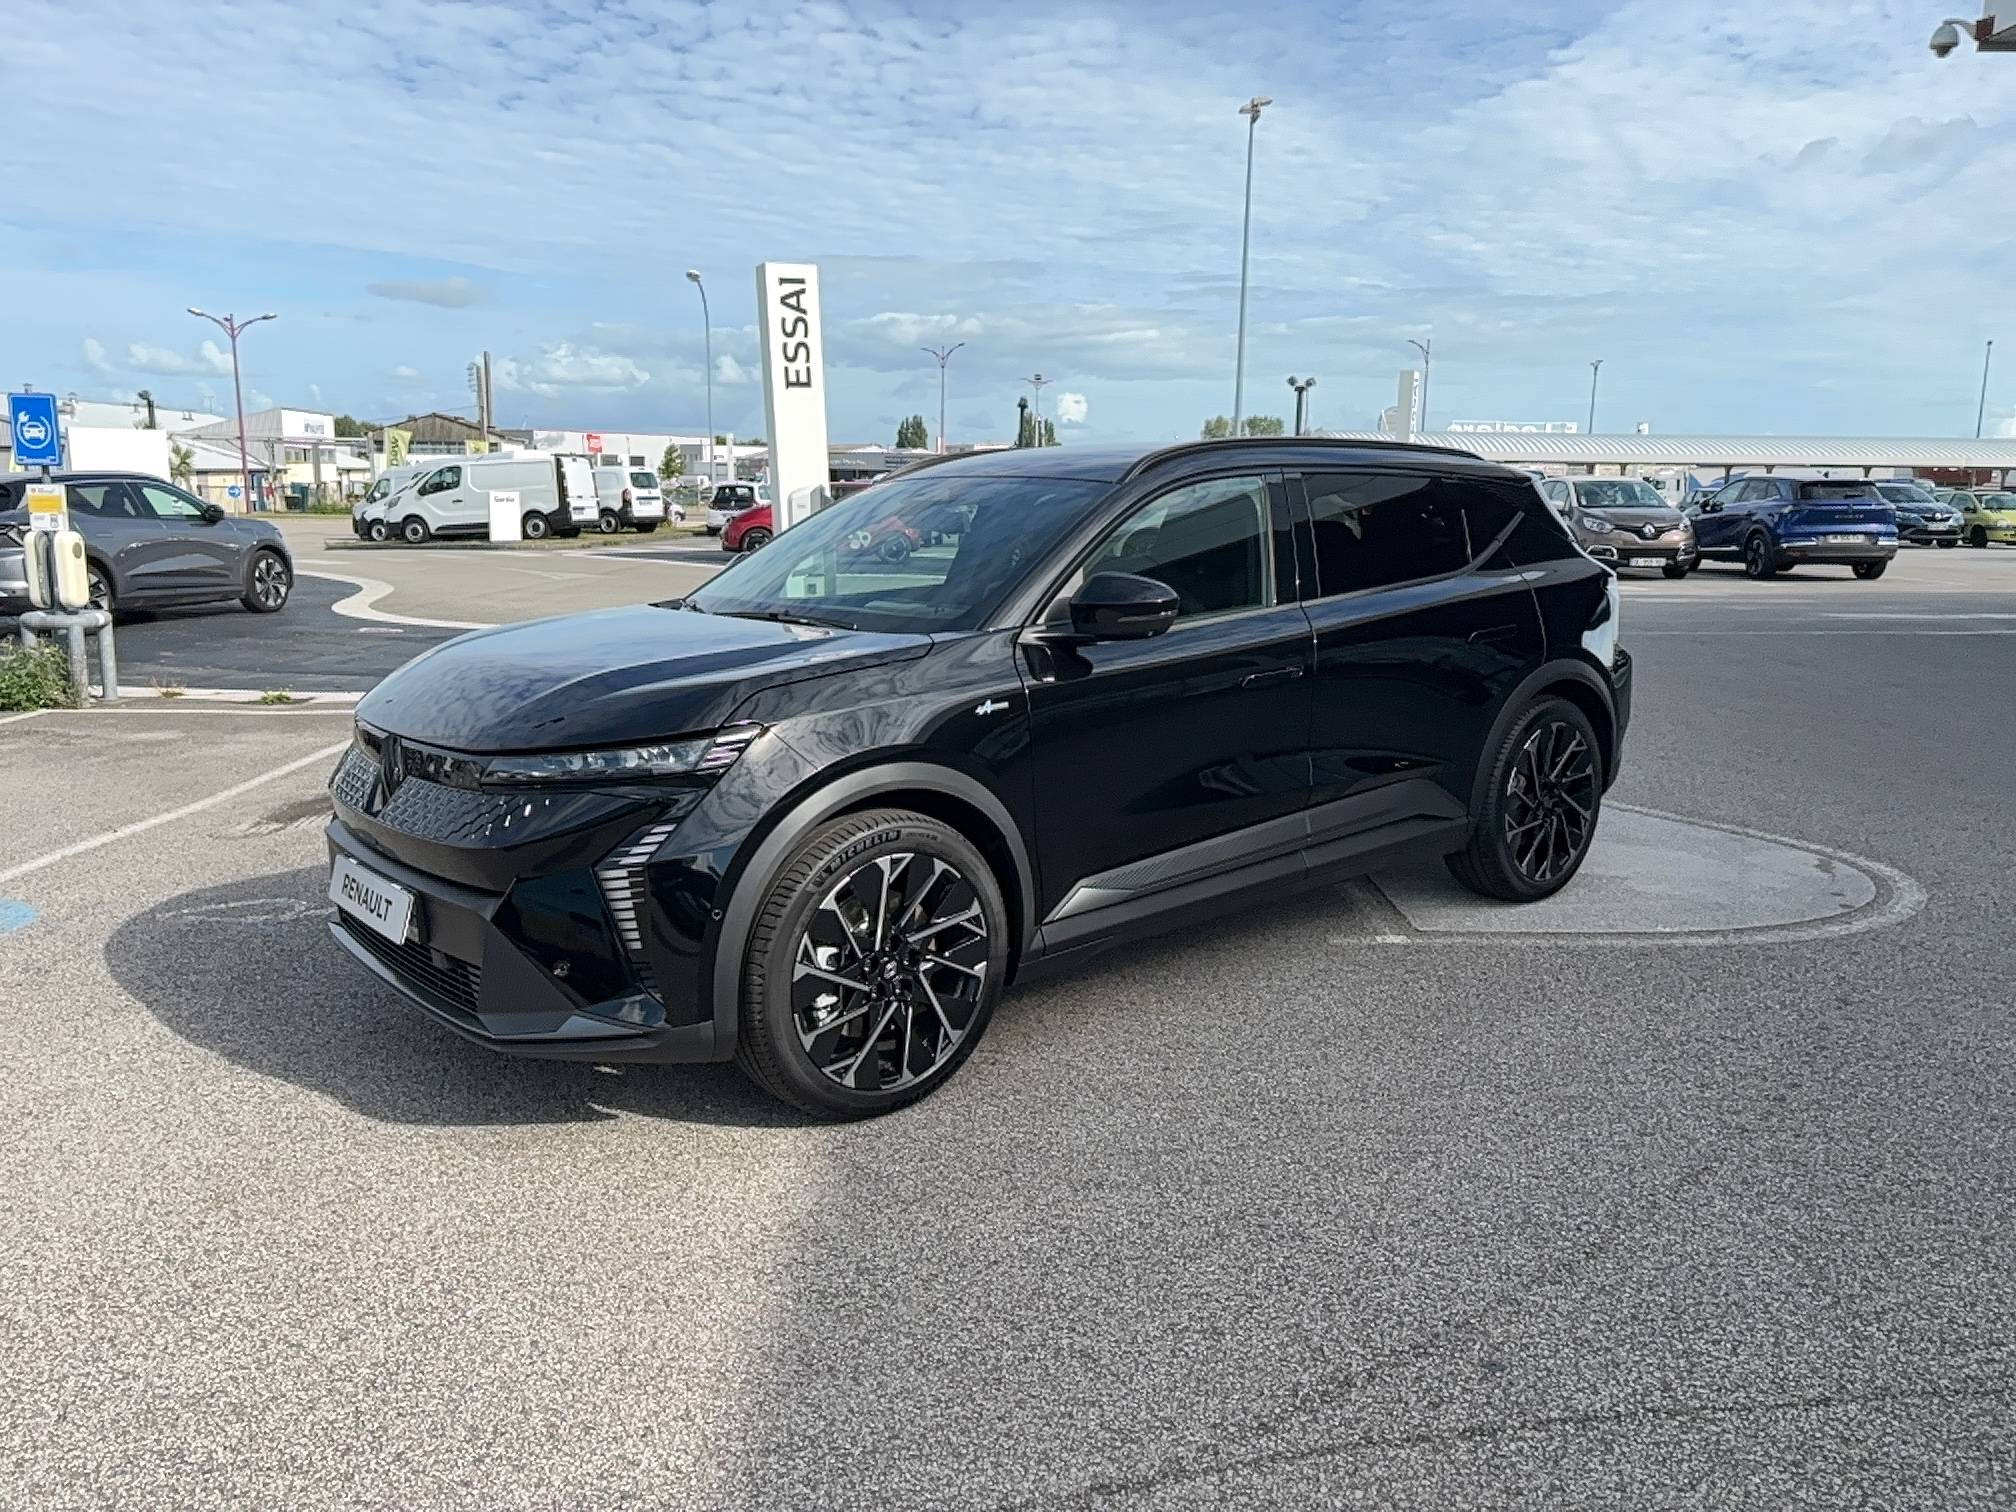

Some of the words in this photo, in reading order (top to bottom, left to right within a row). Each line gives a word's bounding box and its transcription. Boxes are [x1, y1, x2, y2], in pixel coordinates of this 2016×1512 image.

[778, 277, 812, 389] ESSAI
[829, 829, 900, 873] MICHELIN
[341, 872, 393, 922] RENAULT
